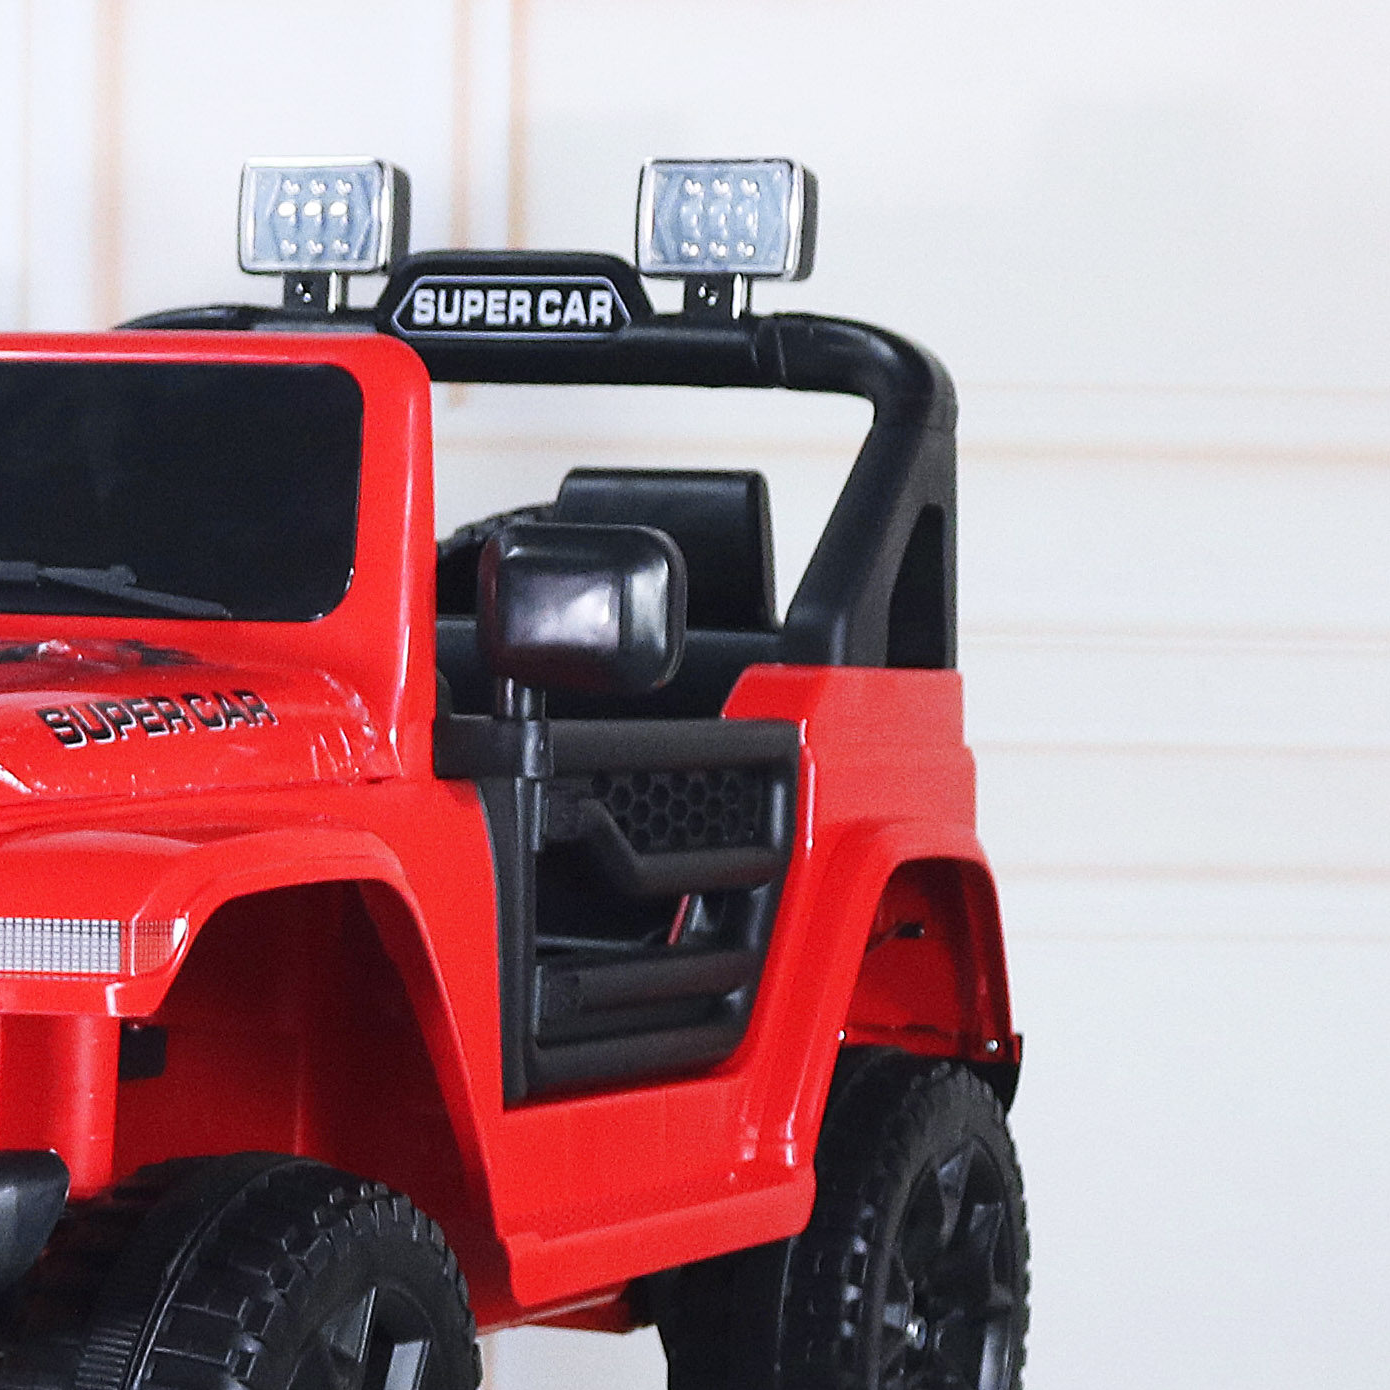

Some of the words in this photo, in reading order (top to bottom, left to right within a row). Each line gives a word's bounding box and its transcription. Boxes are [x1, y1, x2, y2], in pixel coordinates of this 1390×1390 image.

[412, 288, 532, 326] SUPER
[537, 288, 613, 327] CAR
[37, 696, 196, 748] SUPER
[181, 689, 279, 731] CAR
